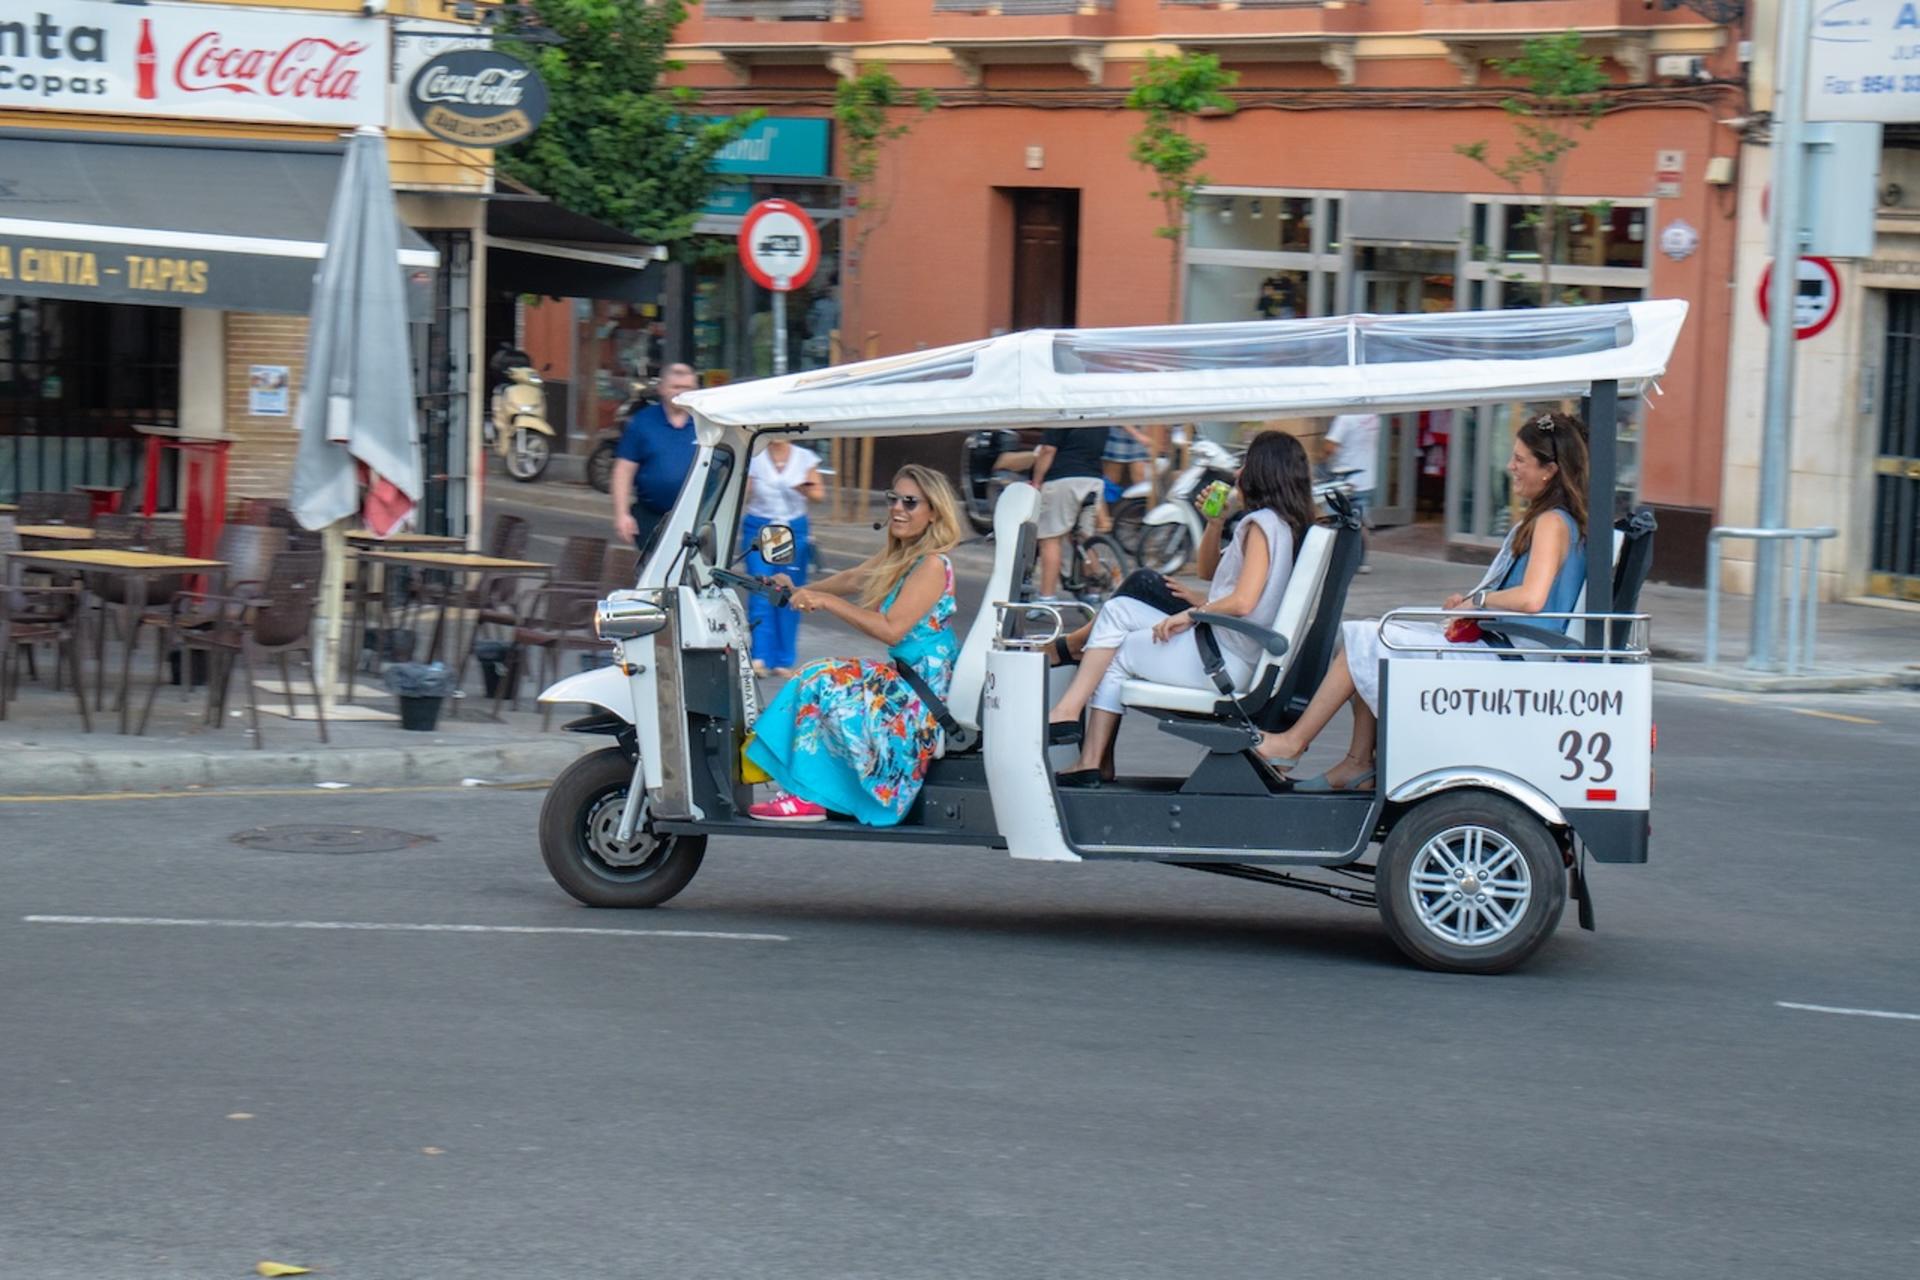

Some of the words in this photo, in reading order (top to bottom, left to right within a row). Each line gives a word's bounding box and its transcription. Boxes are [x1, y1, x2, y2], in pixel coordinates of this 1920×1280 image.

[19, 247, 99, 287] CINTA
[125, 255, 208, 294] TAPAS
[1421, 687, 1623, 716] ECOTUKTUK.COM
[1558, 729, 1614, 783] 33
